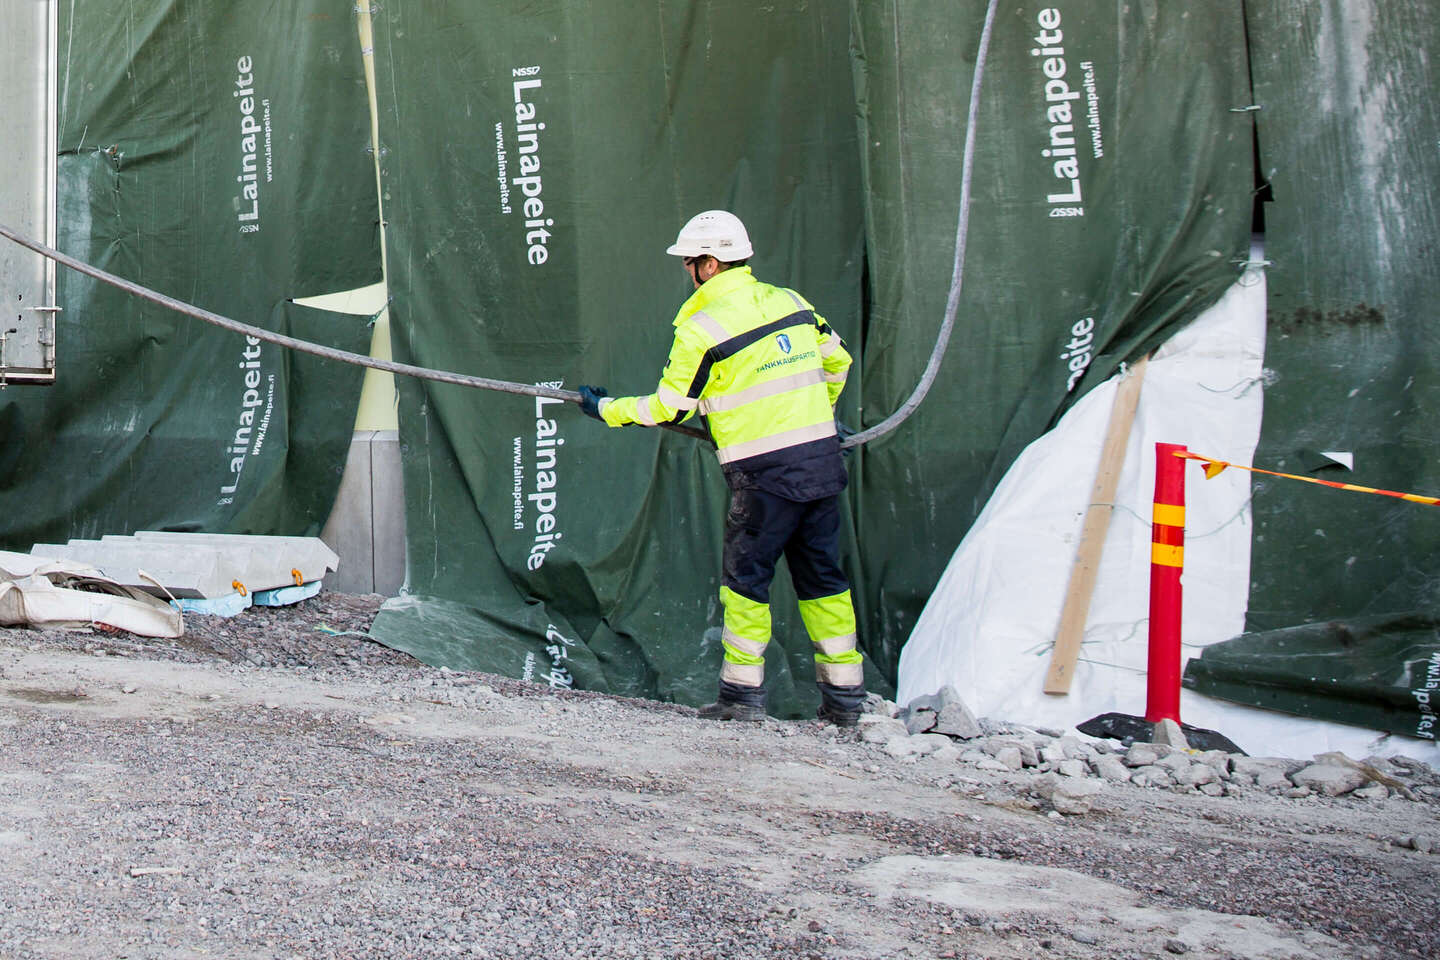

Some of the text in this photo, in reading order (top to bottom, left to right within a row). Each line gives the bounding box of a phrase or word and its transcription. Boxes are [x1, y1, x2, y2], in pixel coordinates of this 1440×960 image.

[233, 55, 262, 222] Lainapeite
[262, 99, 273, 183] www.lainapeite.fi
[494, 122, 512, 214] www.lainapeite.fi
[512, 79, 554, 266] Lainapeite
[1031, 8, 1082, 204] Lainapeite
[1080, 61, 1104, 160] www.lainapeite.fi
[220, 335, 264, 494] Lainapeite
[513, 436, 524, 530] www.lainapeite.fi
[527, 395, 565, 571] Lainapeite
